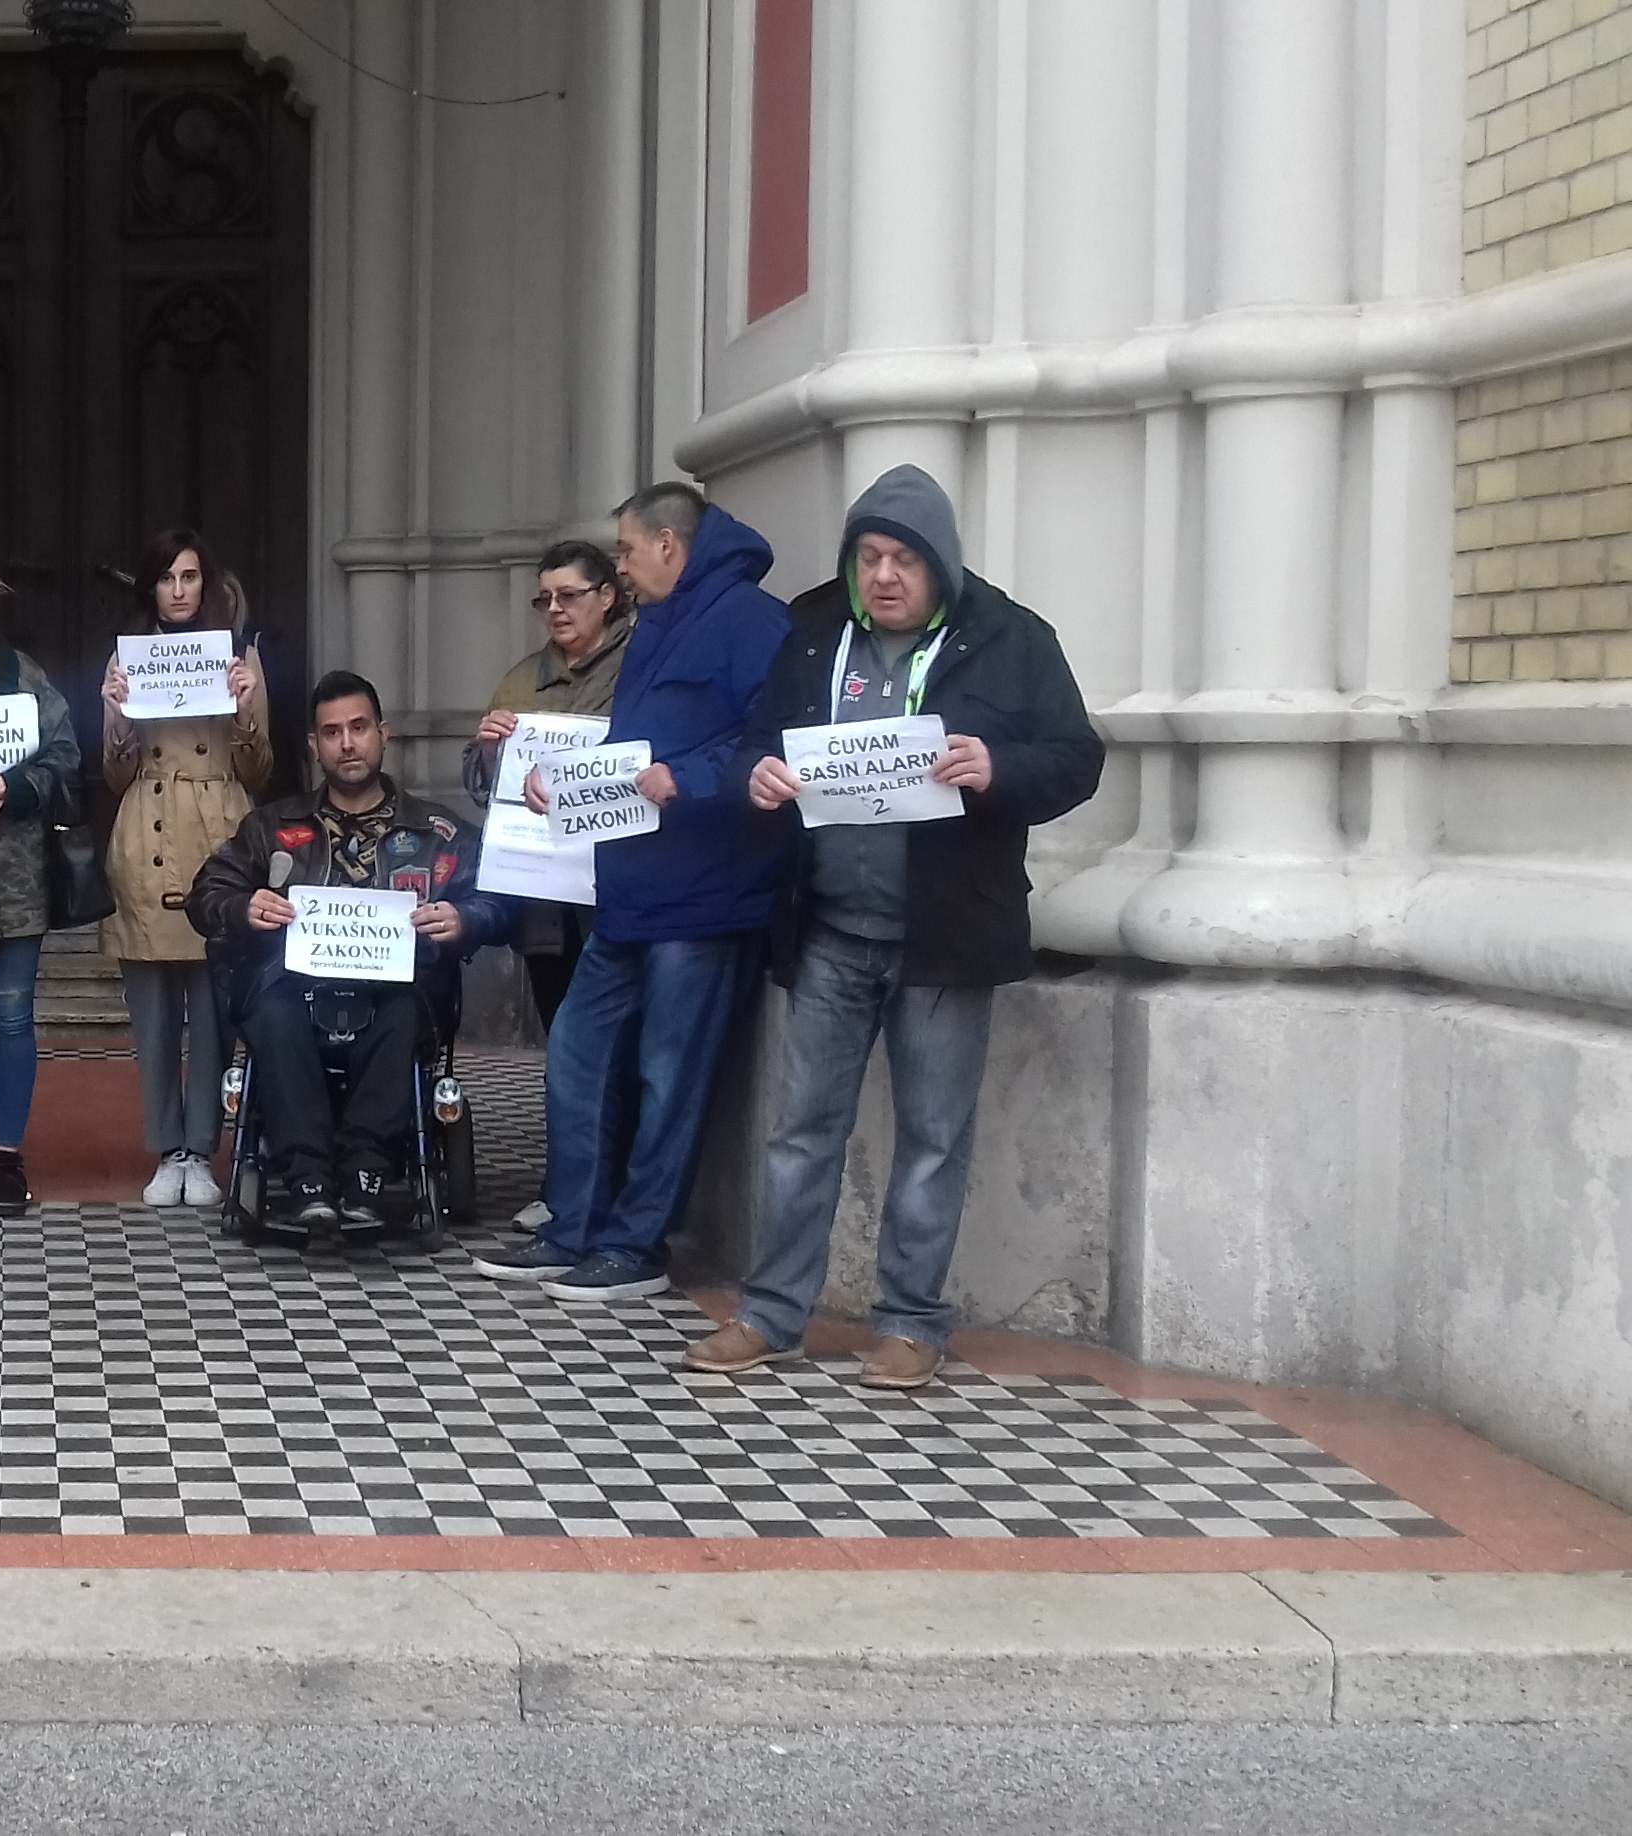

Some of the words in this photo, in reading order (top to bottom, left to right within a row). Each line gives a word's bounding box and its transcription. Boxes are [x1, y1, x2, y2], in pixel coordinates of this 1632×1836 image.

[150, 643, 202, 658] ČUVAM
[127, 661, 171, 676] SAŠIN
[174, 659, 227, 673] ALARM
[140, 680, 181, 690] #SASHA
[182, 678, 214, 688] ALERT
[174, 693, 187, 709] 2
[523, 727, 537, 742] 2
[544, 730, 593, 748] HOĆU
[828, 733, 899, 756] ČUVAM
[552, 769, 562, 785] 2
[563, 756, 617, 783] HOĆU
[799, 760, 859, 783] SAŠIN
[865, 751, 938, 776] ALARM
[821, 783, 877, 797] #SASHA
[879, 775, 924, 791] ALERT
[557, 783, 639, 810] ALEKSIN
[872, 799, 890, 816] 2
[562, 805, 645, 835] ZAKON!!!
[306, 899, 320, 916] 2
[328, 901, 378, 918] HOĆU
[300, 921, 404, 940] VUKAŠINOV
[310, 943, 390, 961] ZAKON!!!
